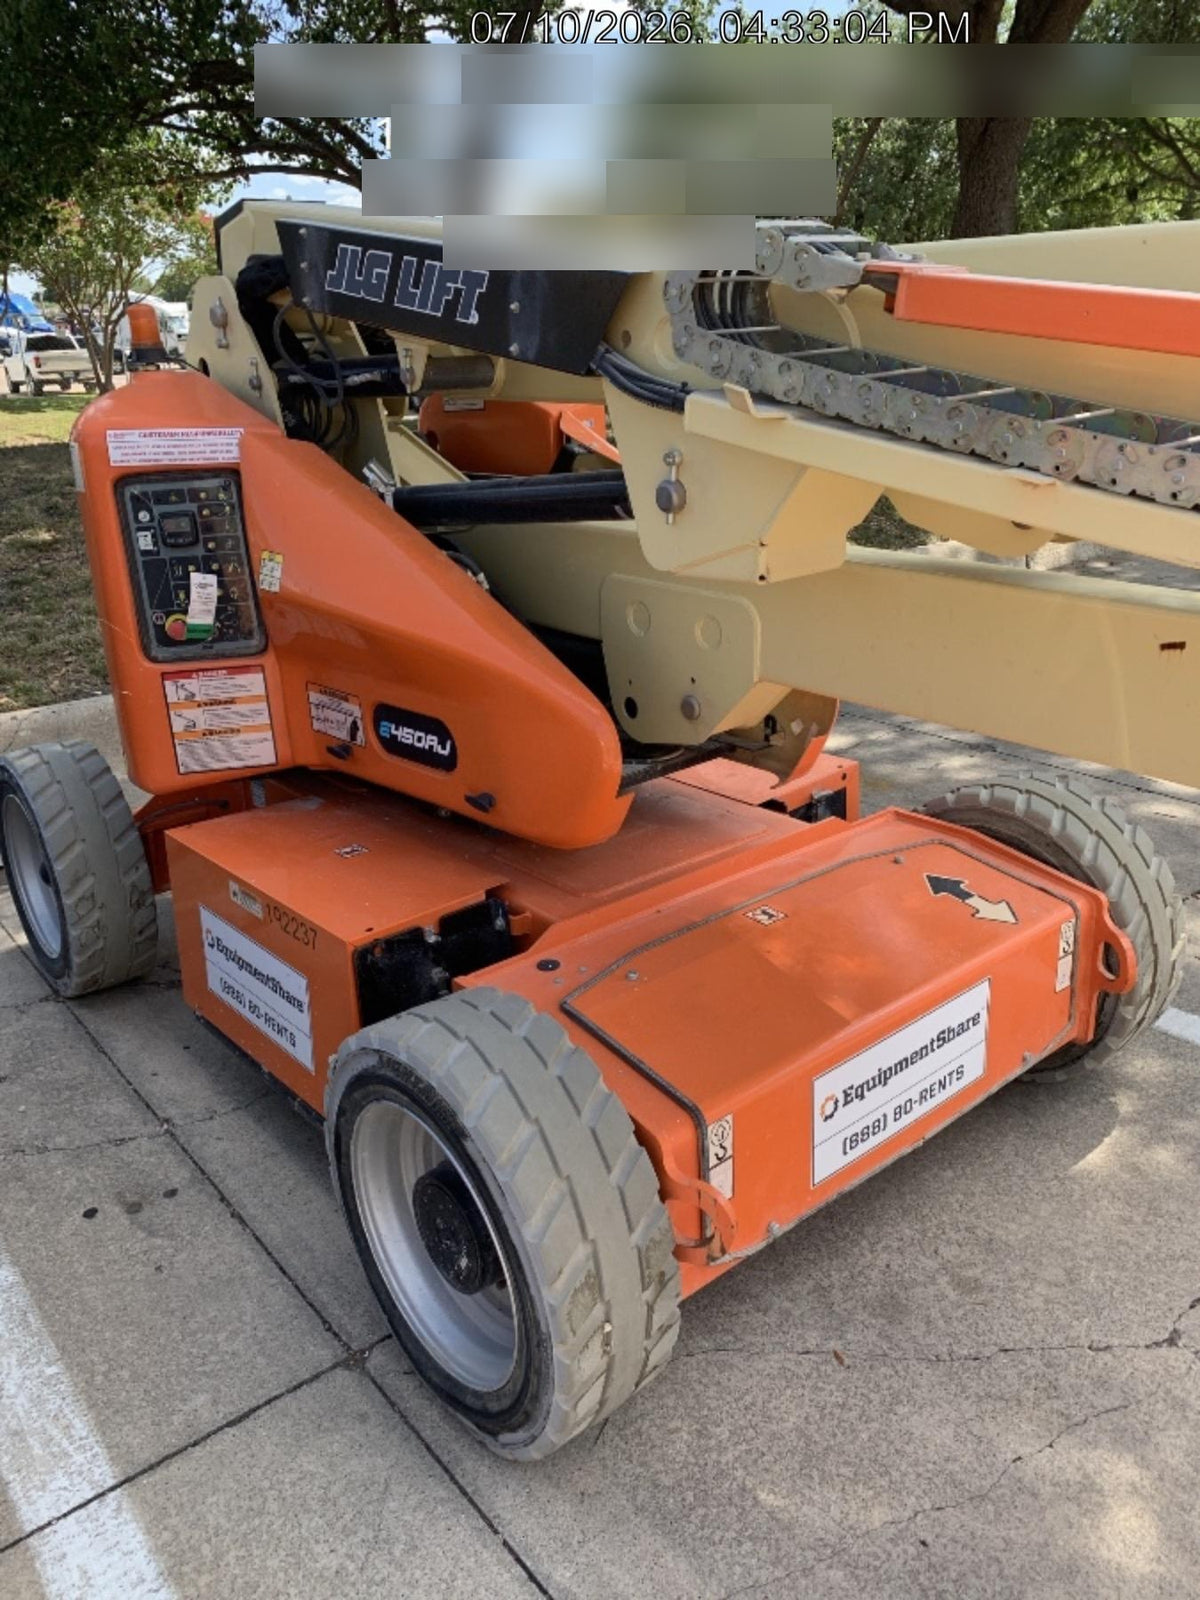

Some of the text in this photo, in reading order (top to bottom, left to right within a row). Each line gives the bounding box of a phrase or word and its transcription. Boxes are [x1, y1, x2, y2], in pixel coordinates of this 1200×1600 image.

[325, 243, 489, 323] JLG LIFT
[379, 720, 452, 756] E450AJ
[266, 904, 318, 950] 192237
[216, 936, 305, 1013] EquipmentShare
[841, 1011, 981, 1107] EquipmentShare
[841, 1063, 965, 1156] (888) 80-RENTS
